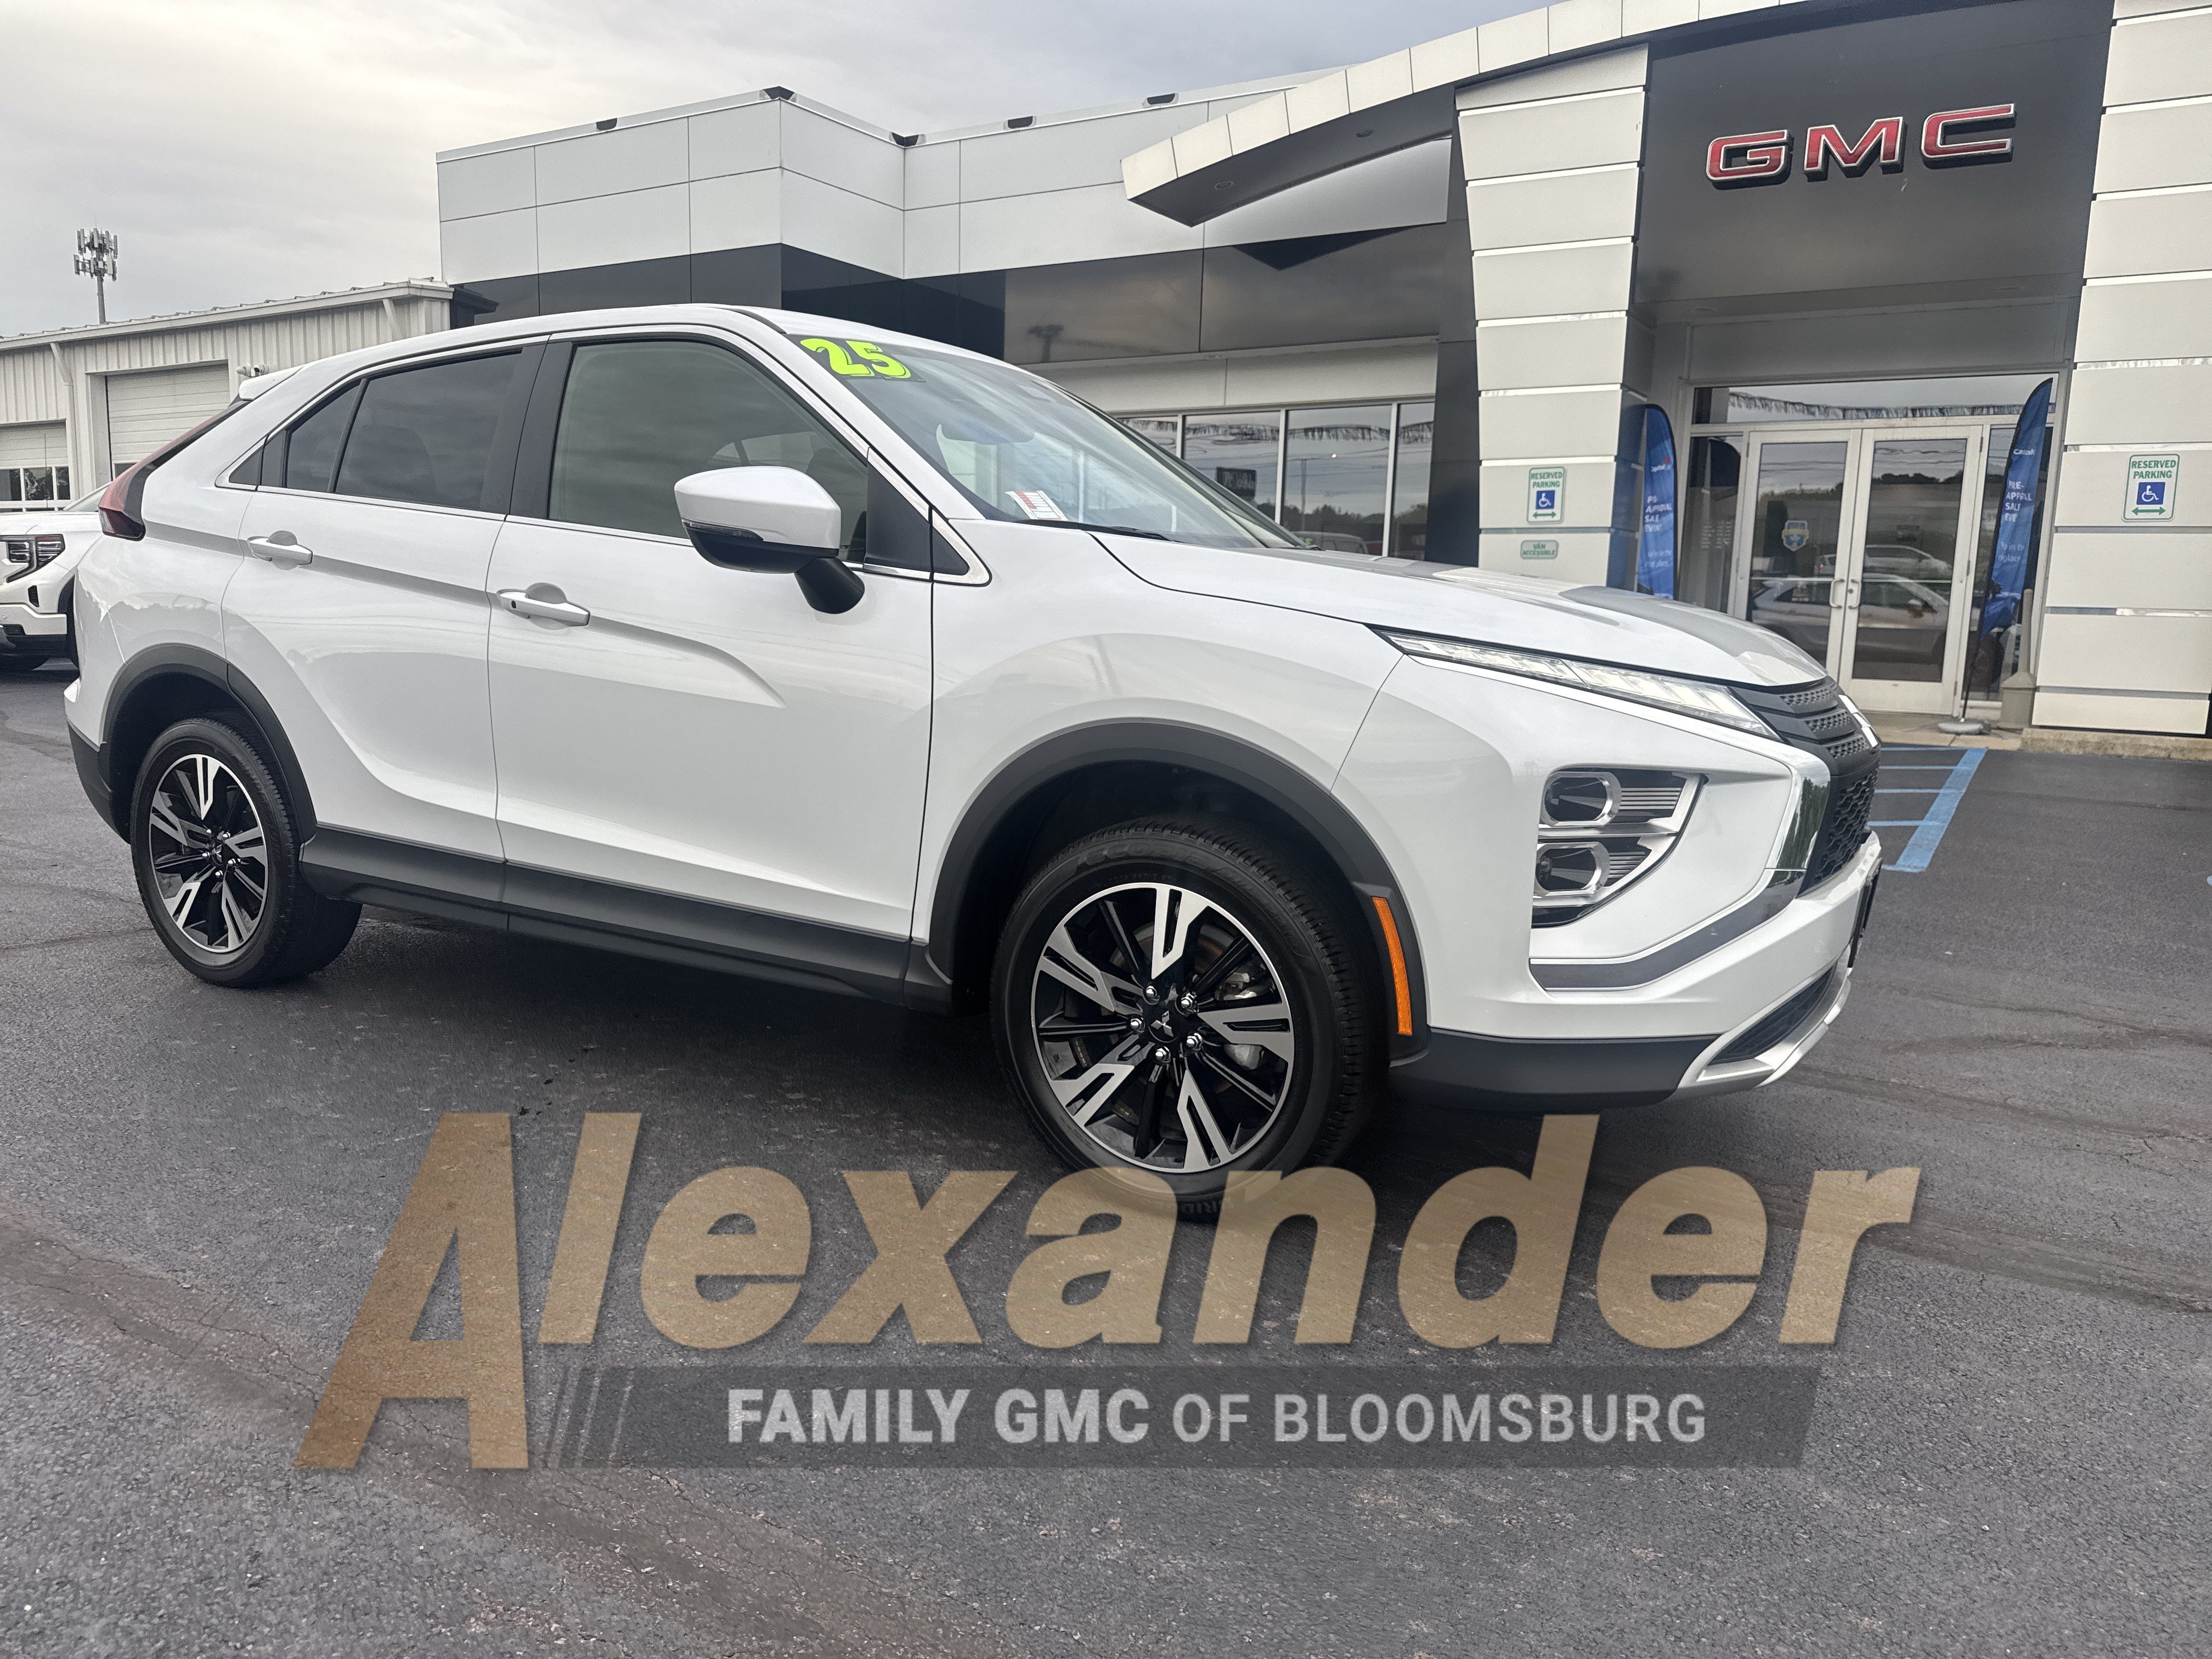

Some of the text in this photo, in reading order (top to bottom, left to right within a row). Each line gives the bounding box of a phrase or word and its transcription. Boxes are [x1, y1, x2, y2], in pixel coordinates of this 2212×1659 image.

[1706, 103, 2016, 185] GMC
[800, 338, 911, 379] 25
[2131, 460, 2176, 469] RESERVED
[1531, 471, 1562, 479] RESERVED
[2133, 470, 2172, 479] PARKING
[1532, 480, 1560, 488] PARKING
